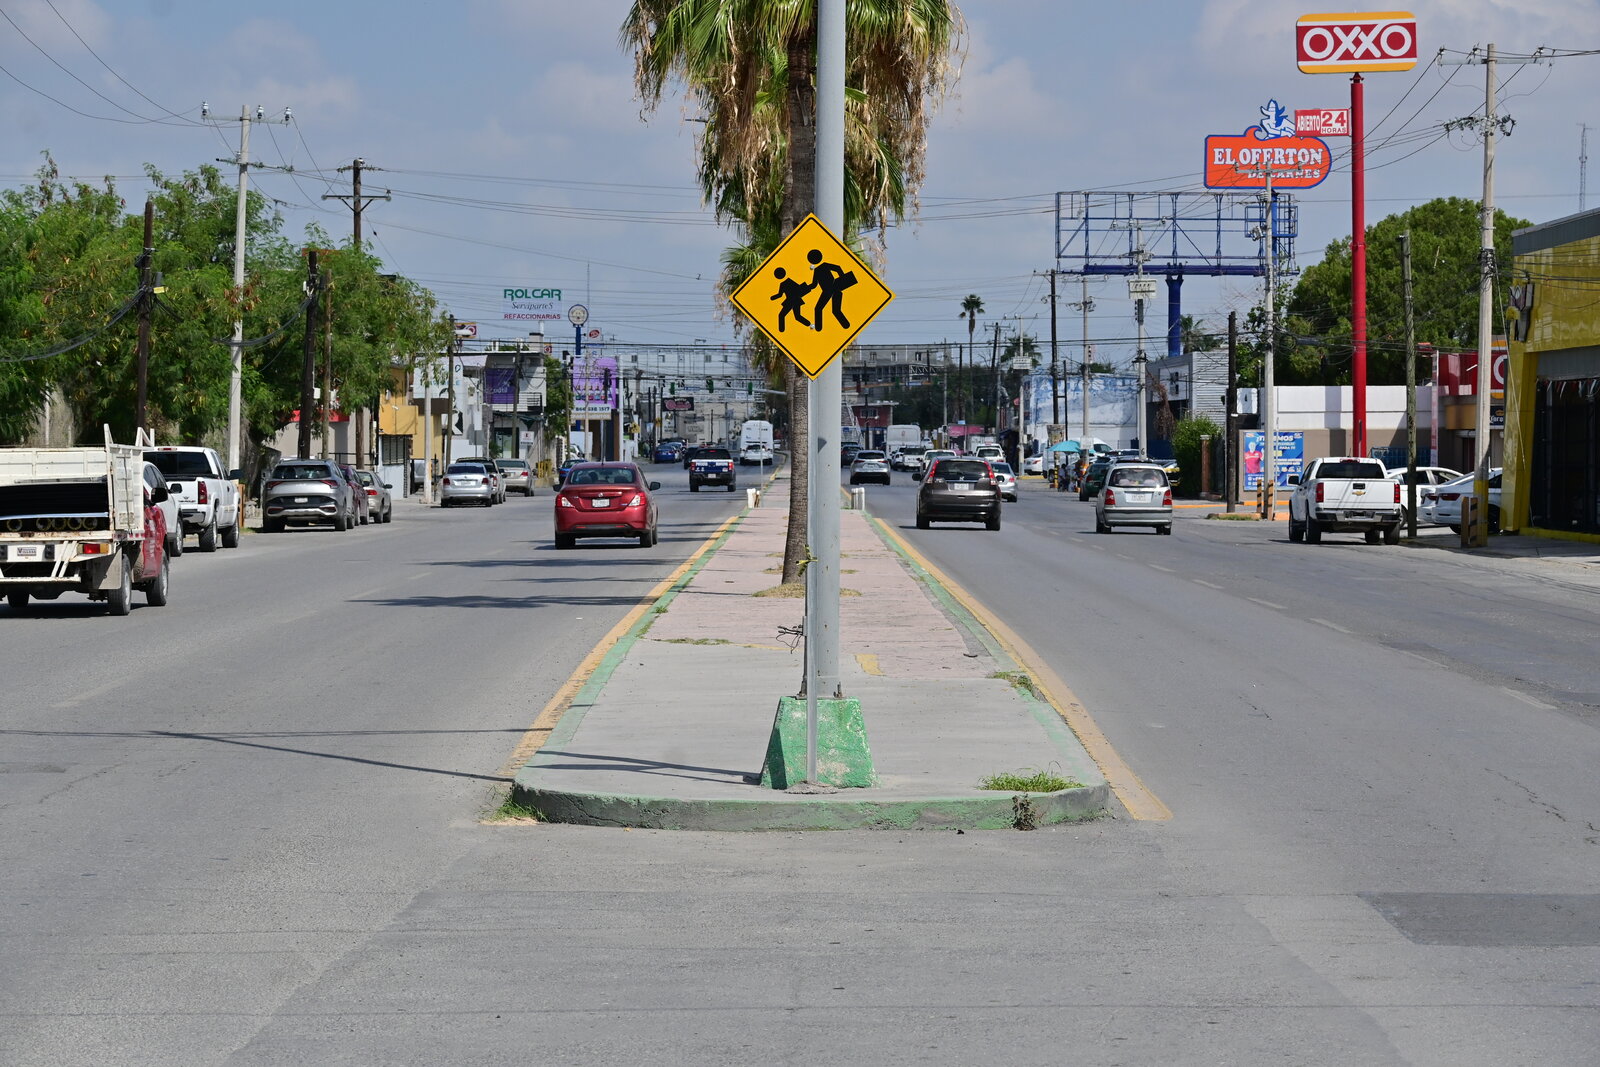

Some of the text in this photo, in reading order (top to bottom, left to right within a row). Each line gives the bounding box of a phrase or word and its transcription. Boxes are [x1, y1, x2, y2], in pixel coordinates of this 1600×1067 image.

[1302, 25, 1412, 59] OXXO
[1296, 110, 1346, 132] ABIERTO 24
[1321, 127, 1347, 135] HORAS
[1213, 148, 1323, 165] EL OFERTON
[1247, 169, 1321, 179] DE CARNES
[504, 289, 562, 301] ROLCAR
[1490, 416, 1504, 424] Coro
